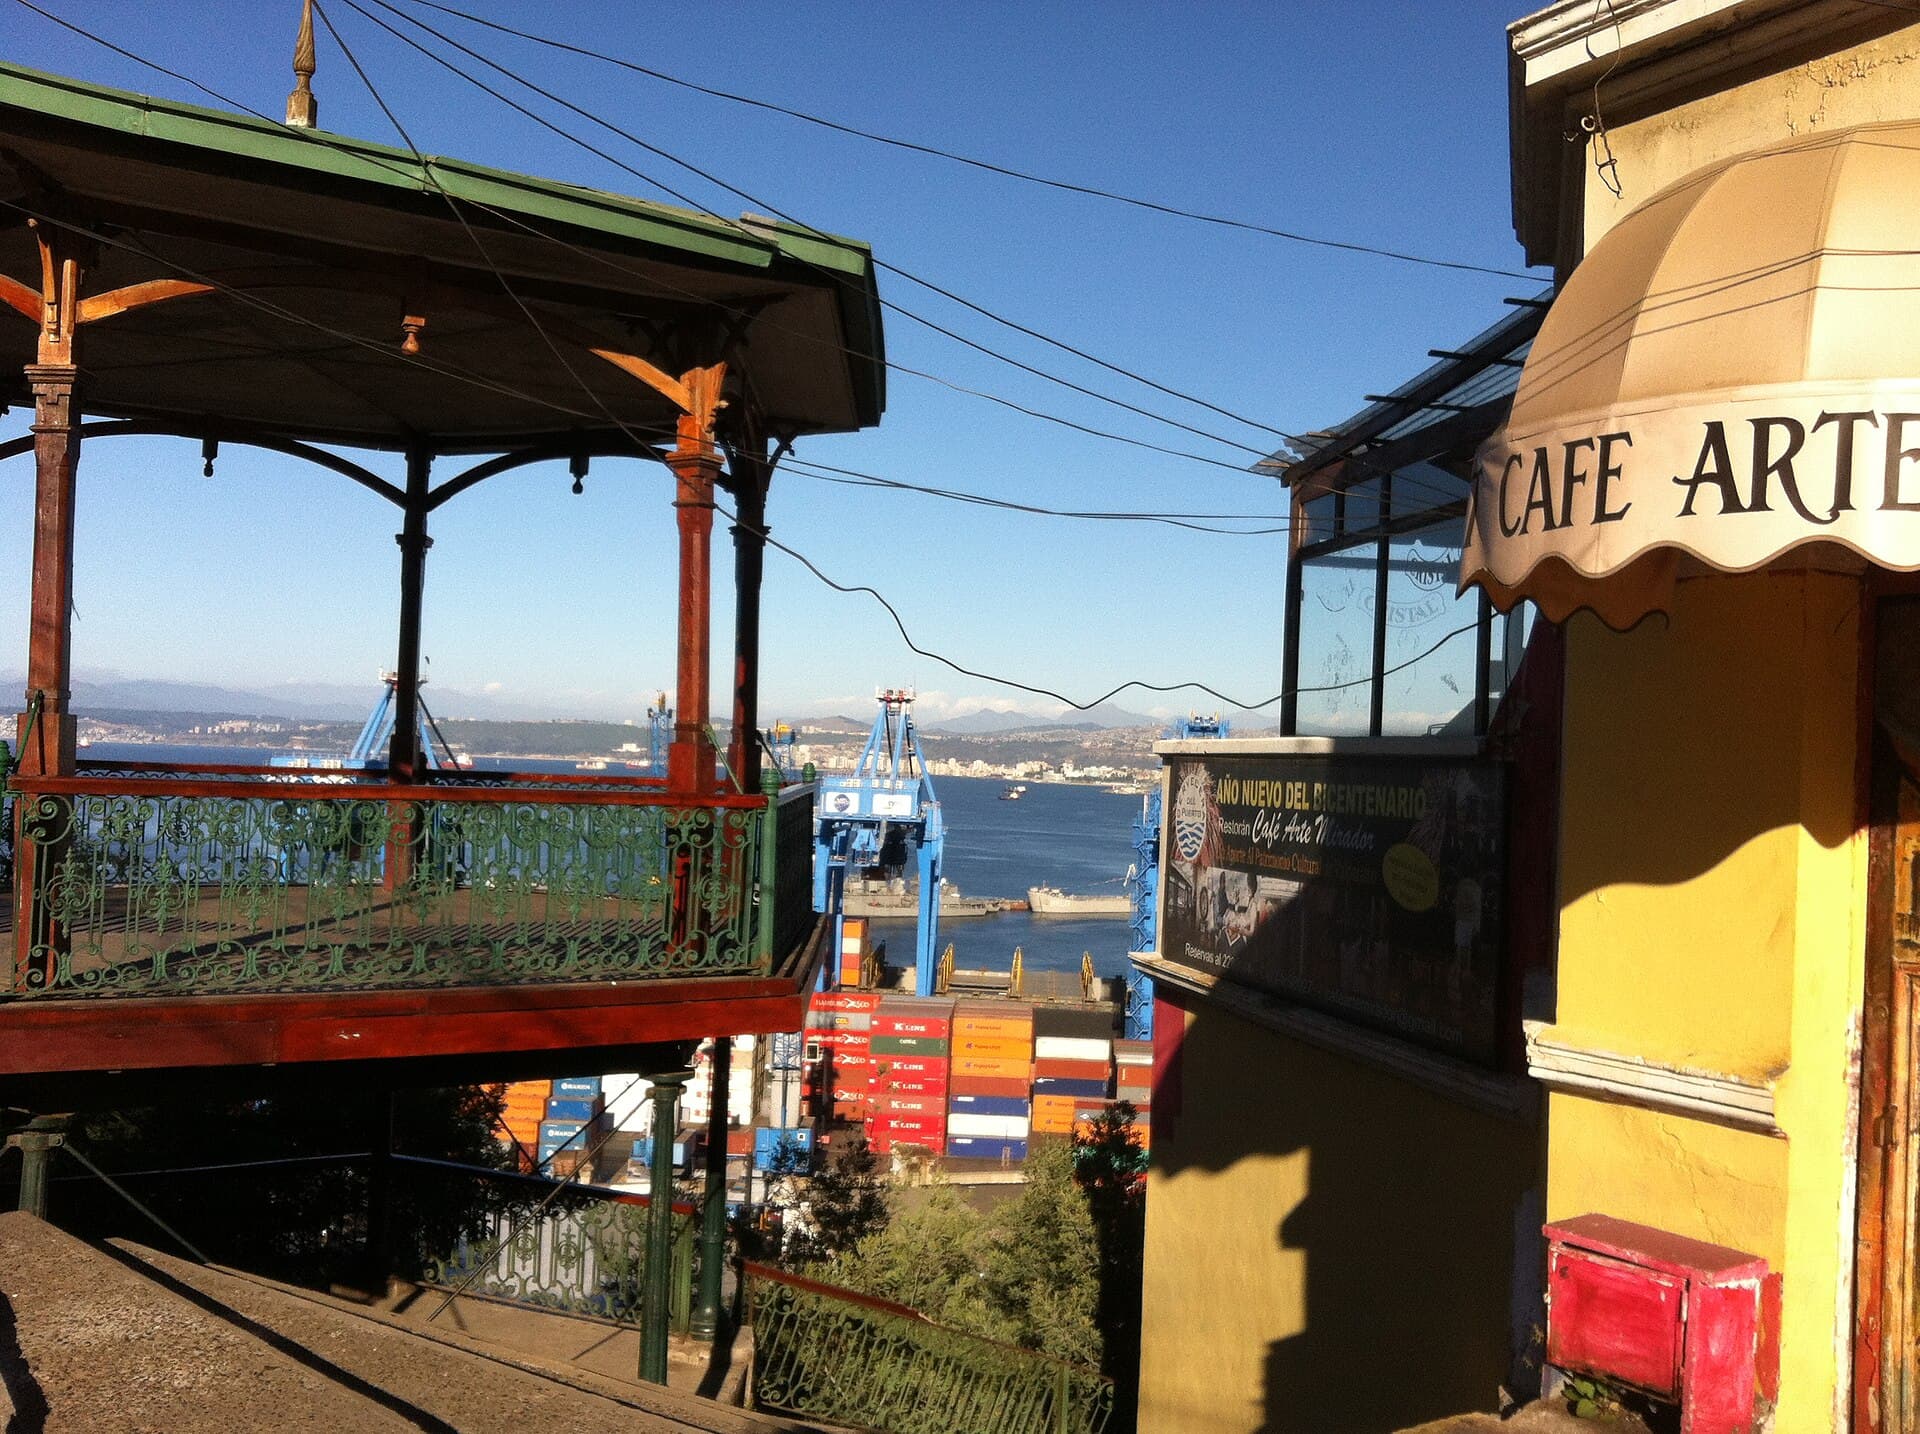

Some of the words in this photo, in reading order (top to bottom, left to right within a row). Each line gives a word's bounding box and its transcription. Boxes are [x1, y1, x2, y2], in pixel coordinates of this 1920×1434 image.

[1499, 431, 1633, 538] CAFE
[1672, 408, 1920, 525] ARTE
[1363, 595, 1439, 623] CISTAL
[1216, 773, 1239, 805] AÑO
[1242, 779, 1282, 809] NUEVO
[1285, 781, 1310, 811] DEL
[1313, 782, 1426, 819] BICENTENARIO
[1218, 816, 1251, 837] Restorán
[1252, 808, 1282, 848] Café
[1281, 811, 1312, 845] Arte
[1314, 813, 1376, 850] Mirador
[1184, 942, 1214, 964] Reservas
